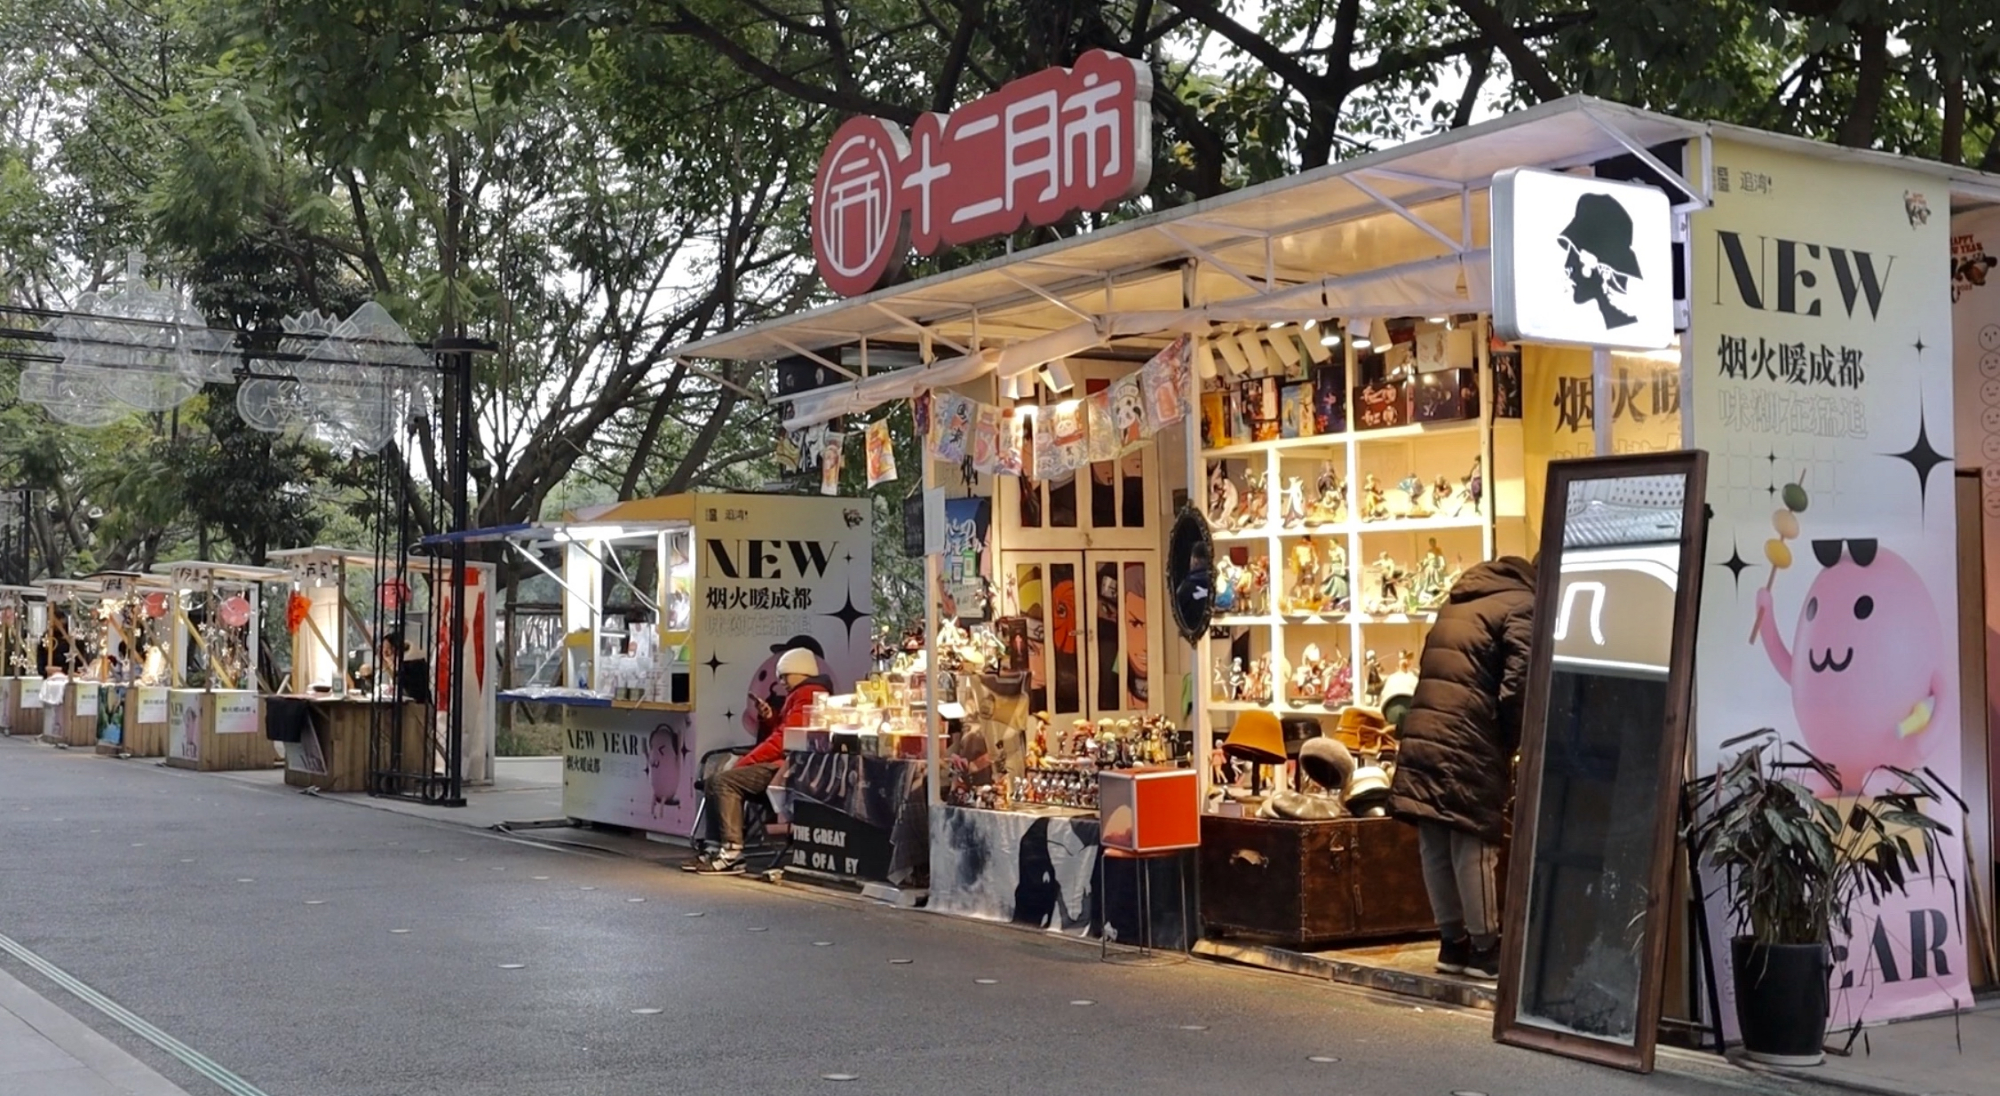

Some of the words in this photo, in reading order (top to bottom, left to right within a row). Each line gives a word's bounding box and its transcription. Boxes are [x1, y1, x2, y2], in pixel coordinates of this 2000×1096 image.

[902, 72, 1122, 235] 十二月市
[1713, 229, 1897, 322] NEW
[1717, 334, 1865, 390] 烟火暖成都
[703, 539, 839, 579] NEW
[706, 586, 812, 610] 烟火暖成都
[567, 728, 595, 750] NEW
[603, 731, 639, 755] YEAR
[790, 823, 810, 842] THE
[813, 828, 846, 847] GREAT
